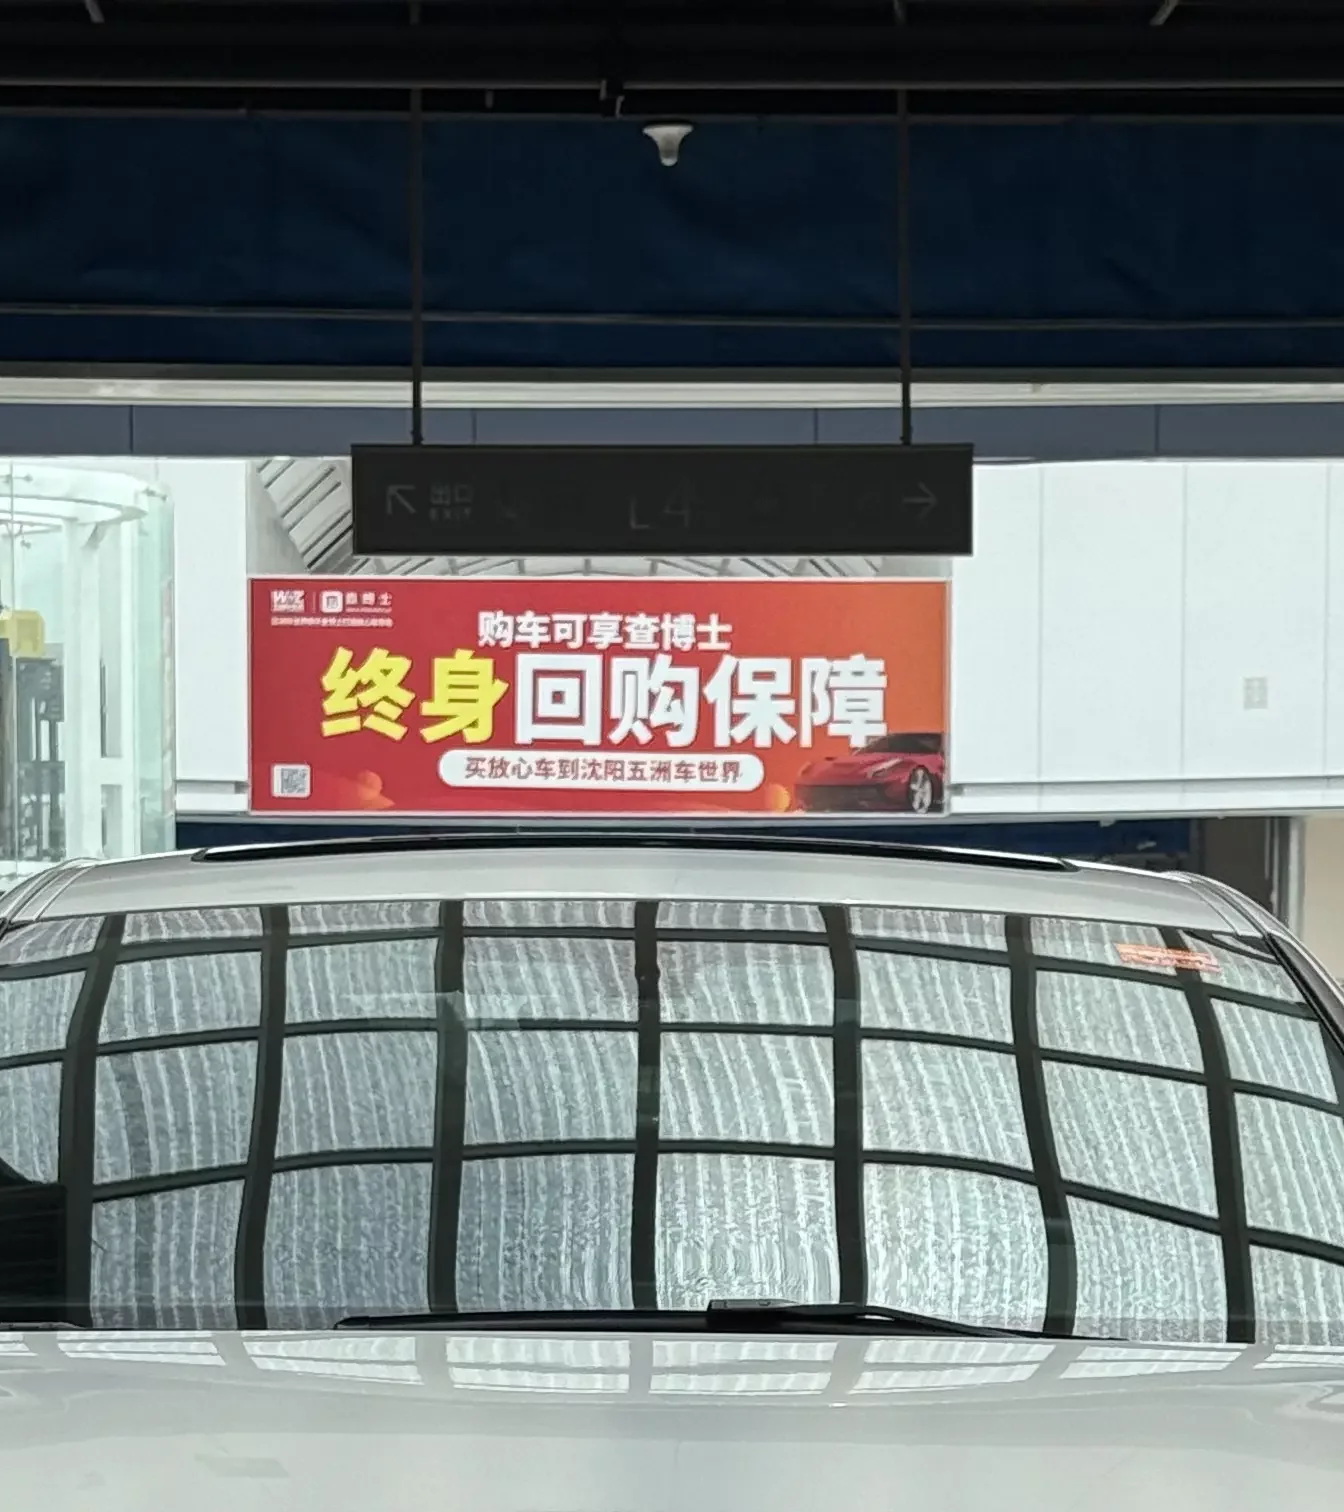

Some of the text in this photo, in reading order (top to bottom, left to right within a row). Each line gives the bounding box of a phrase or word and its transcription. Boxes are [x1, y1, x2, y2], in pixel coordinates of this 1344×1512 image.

[430, 480, 474, 505] 出口
[478, 611, 732, 651] 购车可享查博士
[319, 646, 889, 748] 终身回购保障
[464, 756, 742, 784] 买放心车到沈阳五洲车世界
